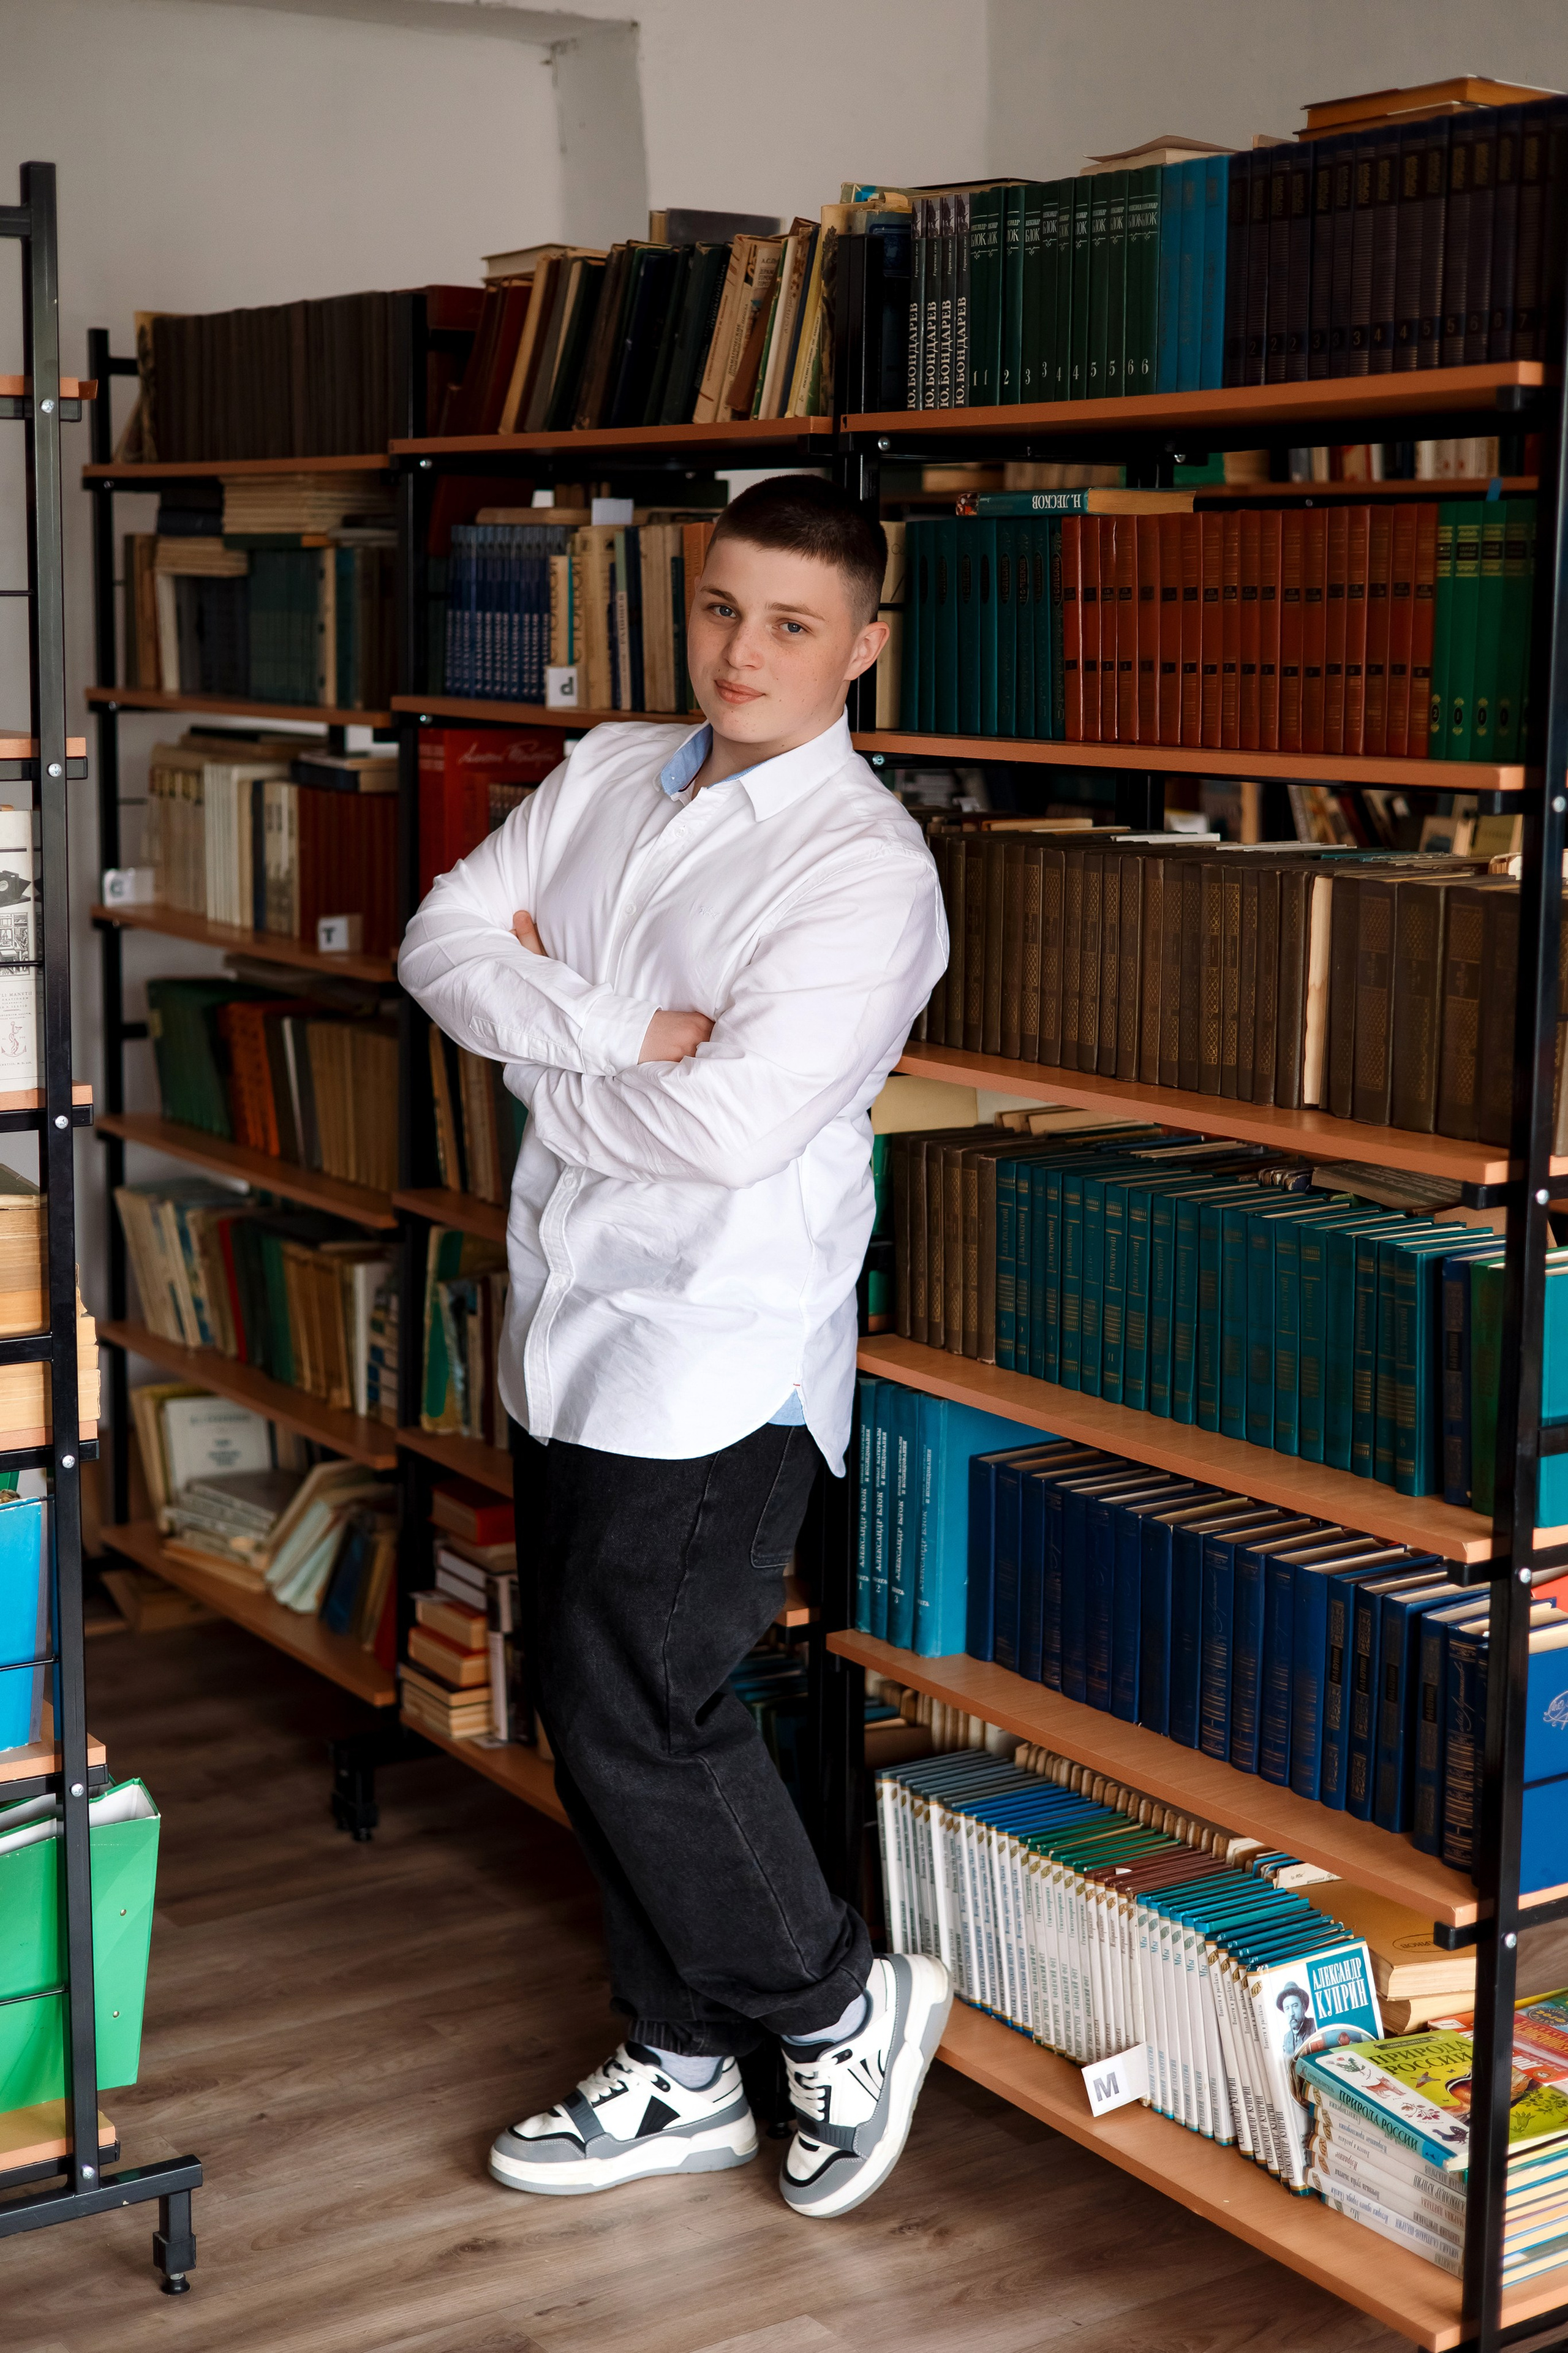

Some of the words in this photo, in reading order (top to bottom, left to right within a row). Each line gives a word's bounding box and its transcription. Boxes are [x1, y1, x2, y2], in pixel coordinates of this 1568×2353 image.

[1025, 228, 1040, 242] БЛОК
[1042, 220, 1057, 234] БЛОК
[908, 303, 919, 387] БОНДАРЕВ
[925, 301, 938, 386] БОНДАРЕВ
[940, 300, 953, 385] БОНДАРЕВ
[956, 297, 968, 382] БОНДАРЕВ
[1042, 361, 1047, 377] 3
[1057, 366, 1061, 382] 4
[1072, 364, 1079, 380] 4
[1090, 361, 1096, 377] 5
[1109, 360, 1115, 376] 5
[1128, 359, 1134, 375] 6
[1142, 358, 1149, 375] 6
[1004, 369, 1009, 385] 2
[1025, 368, 1031, 385] 3
[907, 390, 916, 409] Ю.
[925, 389, 935, 407] Ю.
[940, 388, 949, 407] Ю.
[956, 385, 965, 404] Ю.
[1032, 495, 1069, 509] ЛЕСКОВ
[1071, 494, 1081, 508] Н.
[875, 1584, 881, 1593] 2
[1140, 1936, 1148, 1949] Мы
[1151, 1941, 1159, 1954] Мы
[1163, 1949, 1170, 1962] Мы
[1174, 1954, 1182, 1966] Мы
[1187, 1959, 1195, 1972] Мы
[1200, 1965, 1208, 1977] Мы
[1313, 1957, 1362, 1990] АЛЕКСАНДР
[1314, 1979, 1369, 2020] КУПРИН
[1368, 2041, 1472, 2065] ПРИРОДА
[1382, 2052, 1472, 2075] РОССИИ
[1227, 2077, 1238, 2104] КУПРИН
[1243, 2085, 1255, 2113] КУПРИН
[1255, 2095, 1268, 2123] КУПРИН
[1266, 2103, 1278, 2131] КУПРИН
[1232, 2106, 1245, 2146] АЛЕКСАНДР
[1275, 2111, 1287, 2139] КУПРИН
[1339, 2090, 1379, 2126] ПРИРОДА
[1381, 2118, 1418, 2150] РОССИИ
[1248, 2115, 1261, 2155] АЛЕКСАНДР
[1261, 2124, 1275, 2165] АЛЕКСАНДР
[1281, 2140, 1295, 2181] АЛЕКСАНДР
[1413, 2175, 1434, 2196] КУПРИН
